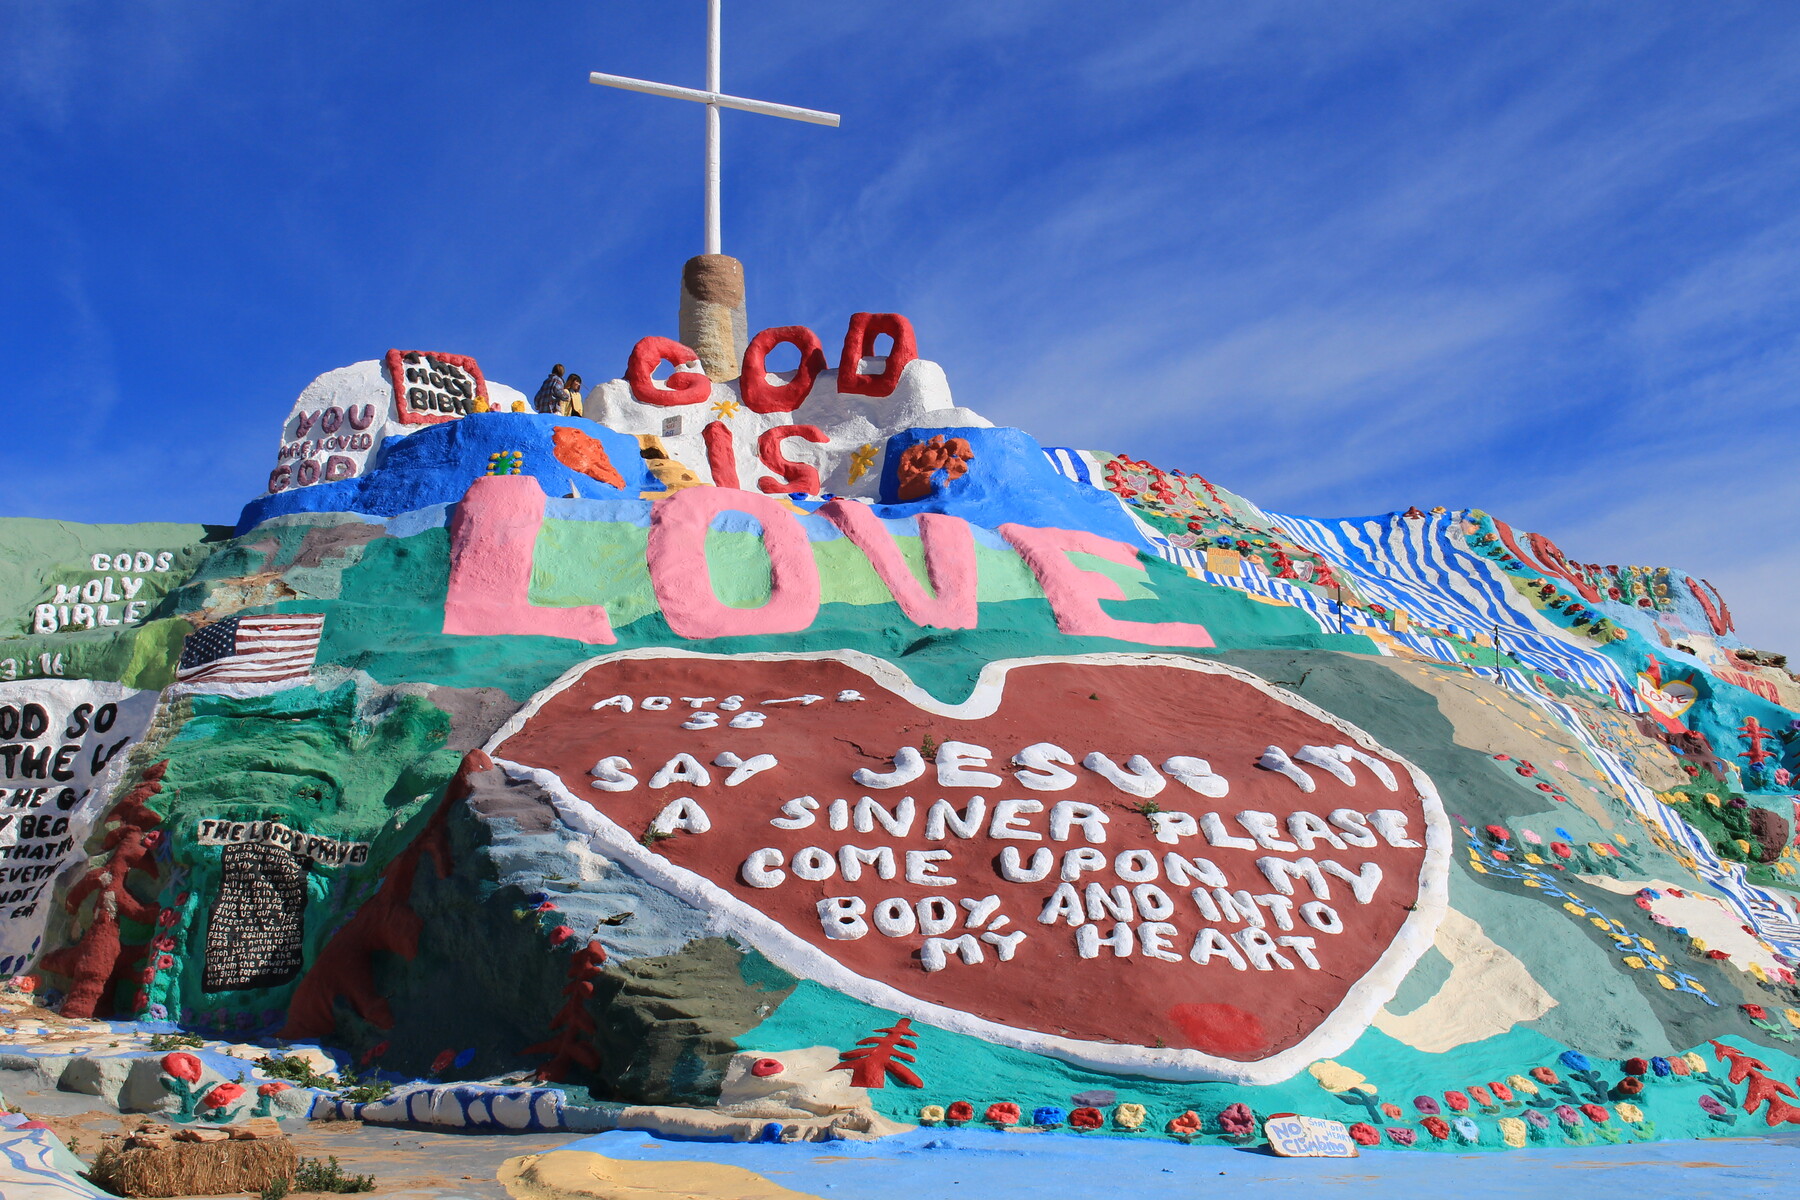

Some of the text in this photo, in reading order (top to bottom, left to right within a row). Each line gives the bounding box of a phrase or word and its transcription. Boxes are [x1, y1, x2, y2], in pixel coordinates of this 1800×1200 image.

[625, 312, 918, 413] GOD
[406, 368, 472, 399] HOLY
[296, 404, 375, 439] YOU
[278, 433, 373, 460] ARE LOVED
[702, 421, 830, 496] IS
[268, 455, 357, 494] GOD
[91, 552, 174, 572] GODS
[443, 476, 1216, 648] LOVE
[52, 576, 143, 604] HOLY
[0, 652, 65, 680] 3:16
[591, 694, 745, 713] ACTS
[1641, 682, 1689, 704] LOVE
[0, 702, 118, 740] OD SO
[0, 744, 81, 781] THE
[590, 751, 779, 792] SAY
[852, 740, 1230, 798] JESUS
[202, 820, 245, 842] THE
[651, 795, 1423, 851] A SINNER PLEASE
[742, 844, 1383, 905] COME UPON MY
[1037, 882, 1175, 926] AND
[1191, 887, 1344, 935] INTO
[920, 921, 1321, 973] MY HEART
[1270, 1122, 1302, 1140] NO
